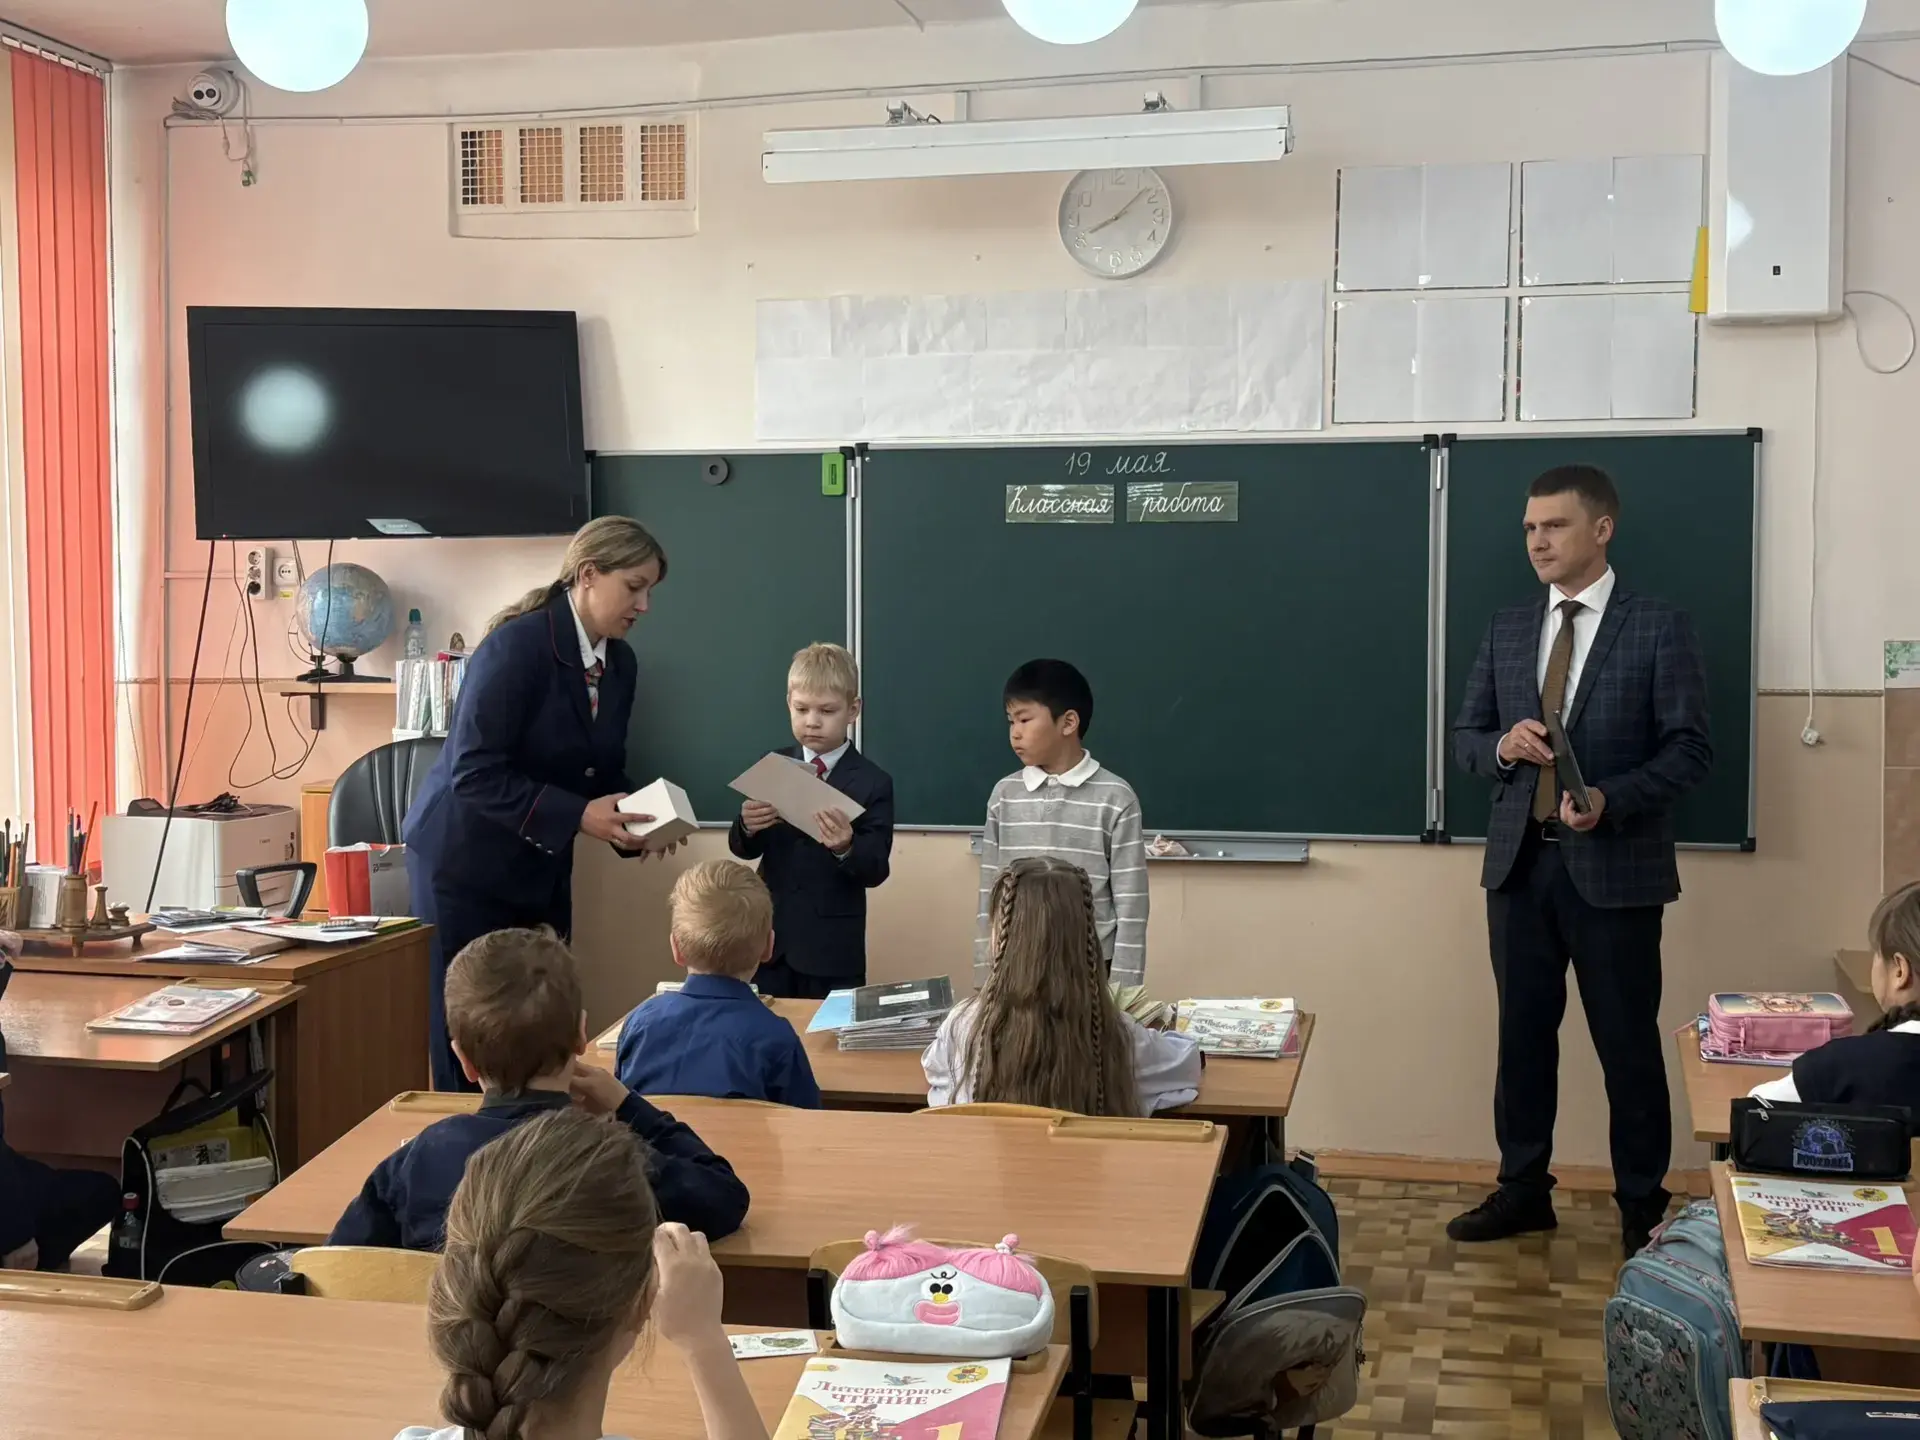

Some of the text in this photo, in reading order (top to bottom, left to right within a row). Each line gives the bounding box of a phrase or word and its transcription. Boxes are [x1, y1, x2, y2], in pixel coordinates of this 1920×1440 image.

[1110, 169, 1126, 186] 12
[1078, 191, 1092, 208] 10
[1146, 190, 1158, 204] 2
[1068, 211, 1080, 228] 9
[1152, 208, 1164, 225] 3
[1074, 232, 1088, 249] 8
[1147, 230, 1157, 242] 4
[1092, 246, 1103, 262] 7
[1109, 250, 1123, 268] 6
[1064, 451, 1092, 476] 19
[1008, 482, 1225, 522] Классная работа
[1748, 1190, 1865, 1209] Литературное
[1861, 1226, 1907, 1256] 1
[812, 1380, 953, 1398] Литературное
[831, 1393, 929, 1405] ЧТЕНИЕ
